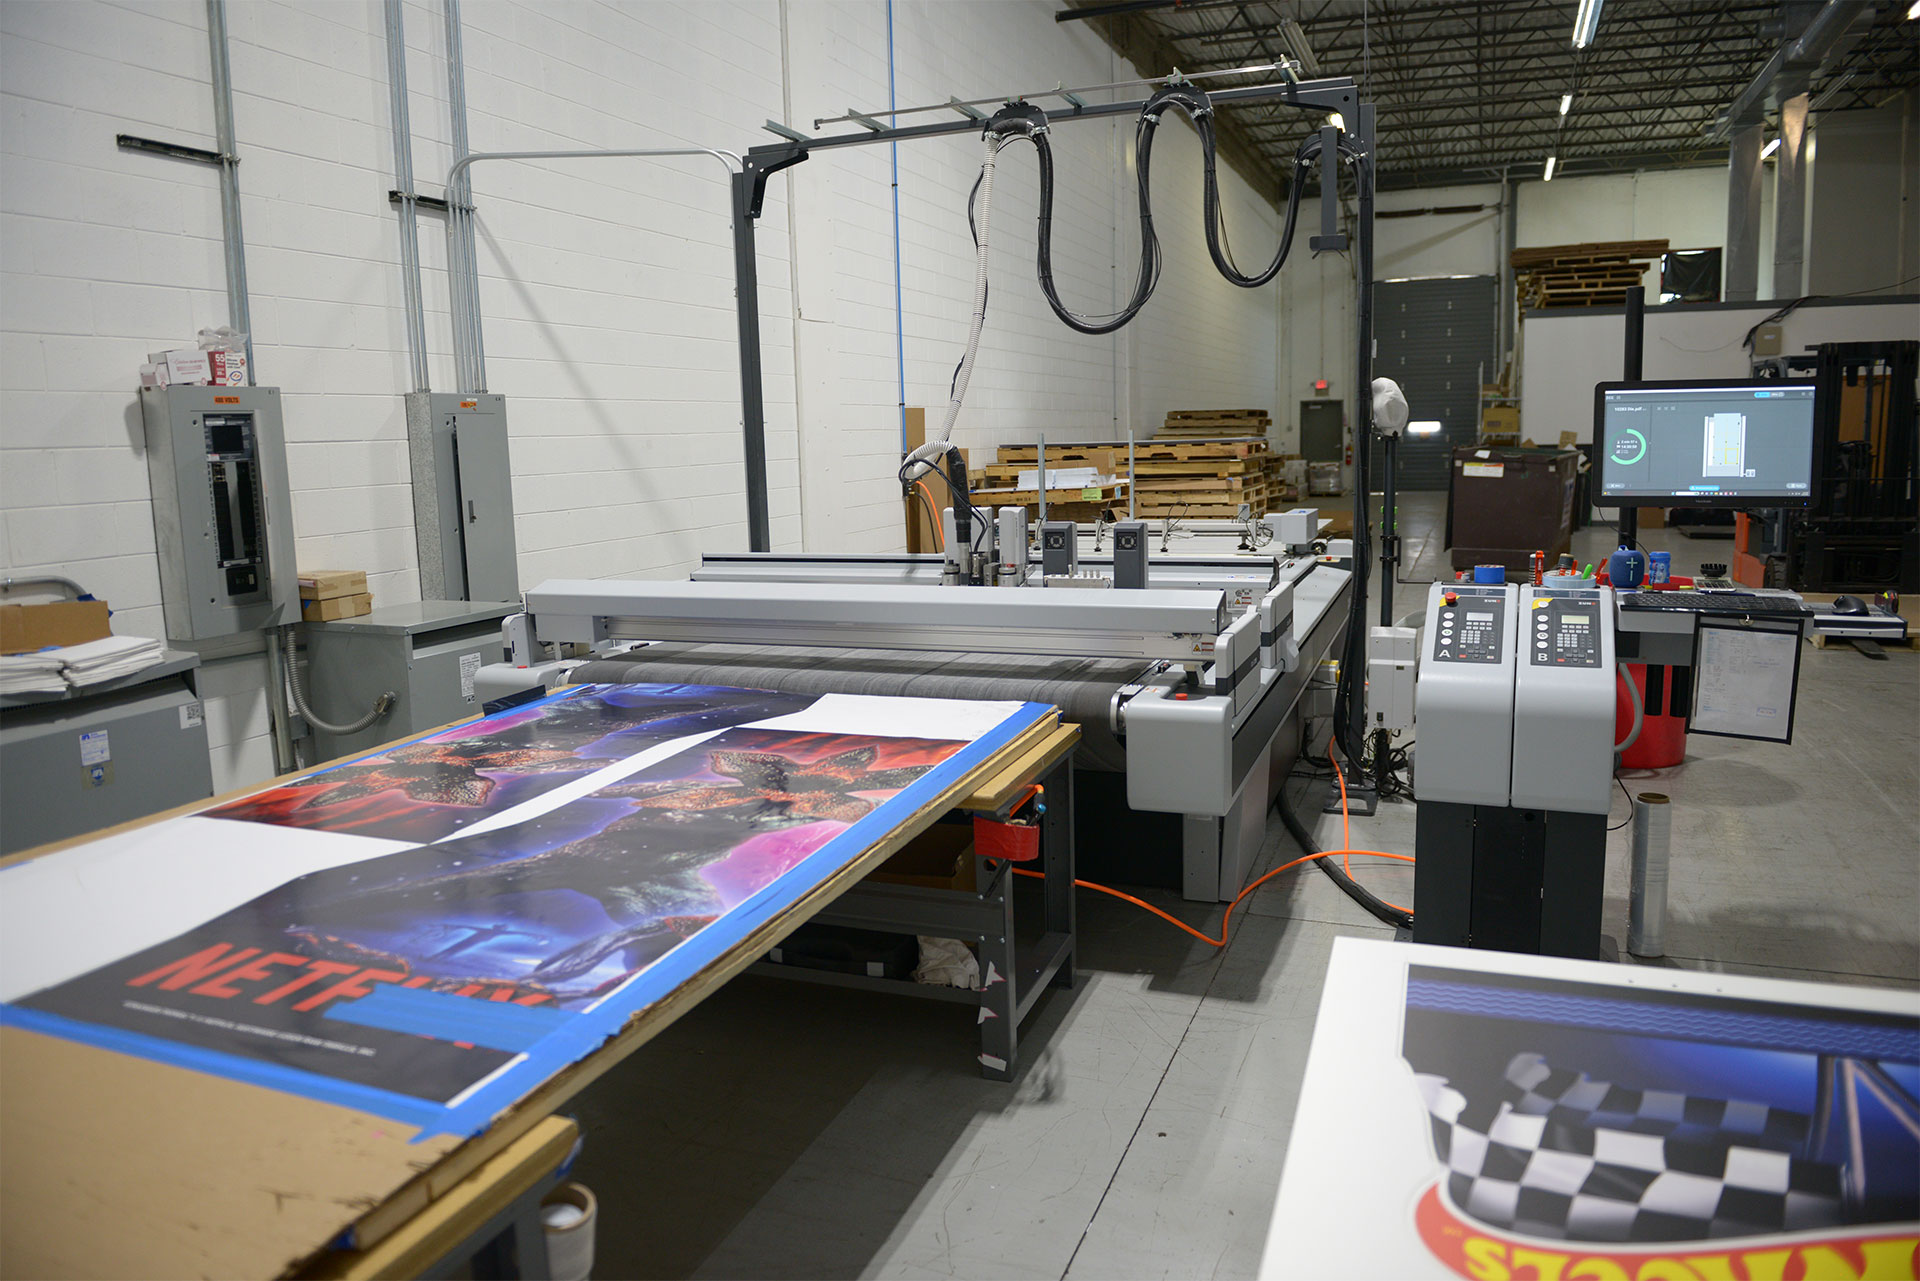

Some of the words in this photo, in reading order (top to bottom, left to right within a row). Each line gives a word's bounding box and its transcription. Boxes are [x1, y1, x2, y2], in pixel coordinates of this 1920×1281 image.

[215, 353, 225, 362] 55
[1438, 649, 1451, 658] A
[1537, 653, 1548, 661] B
